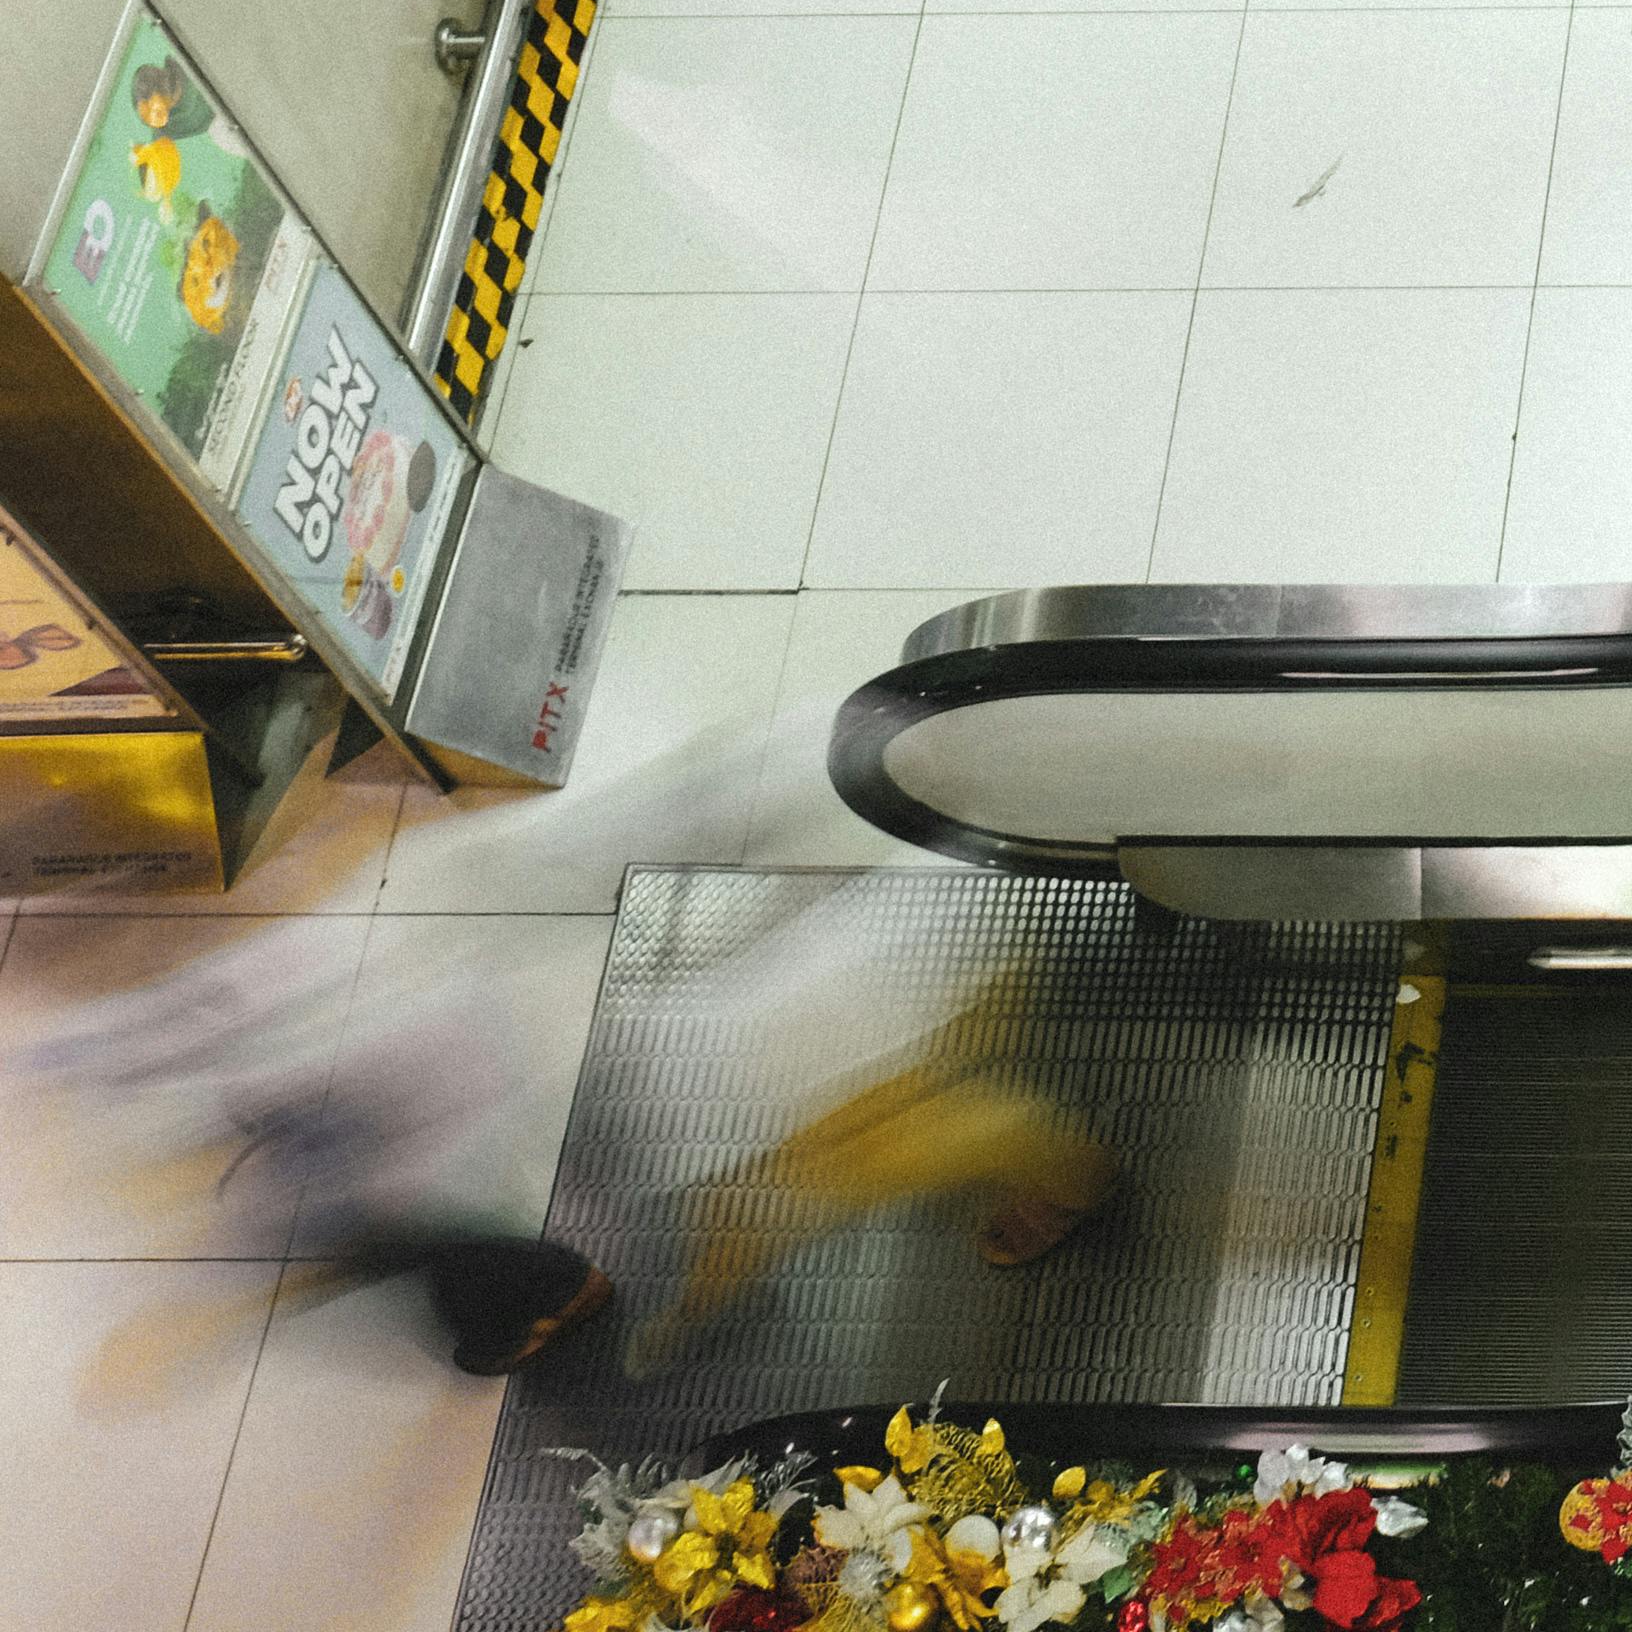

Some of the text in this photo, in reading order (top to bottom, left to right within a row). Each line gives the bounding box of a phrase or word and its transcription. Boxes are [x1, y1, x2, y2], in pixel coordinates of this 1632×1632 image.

[275, 323, 352, 539] NOW
[303, 359, 379, 562] OPEN
[531, 681, 570, 753] PITX
